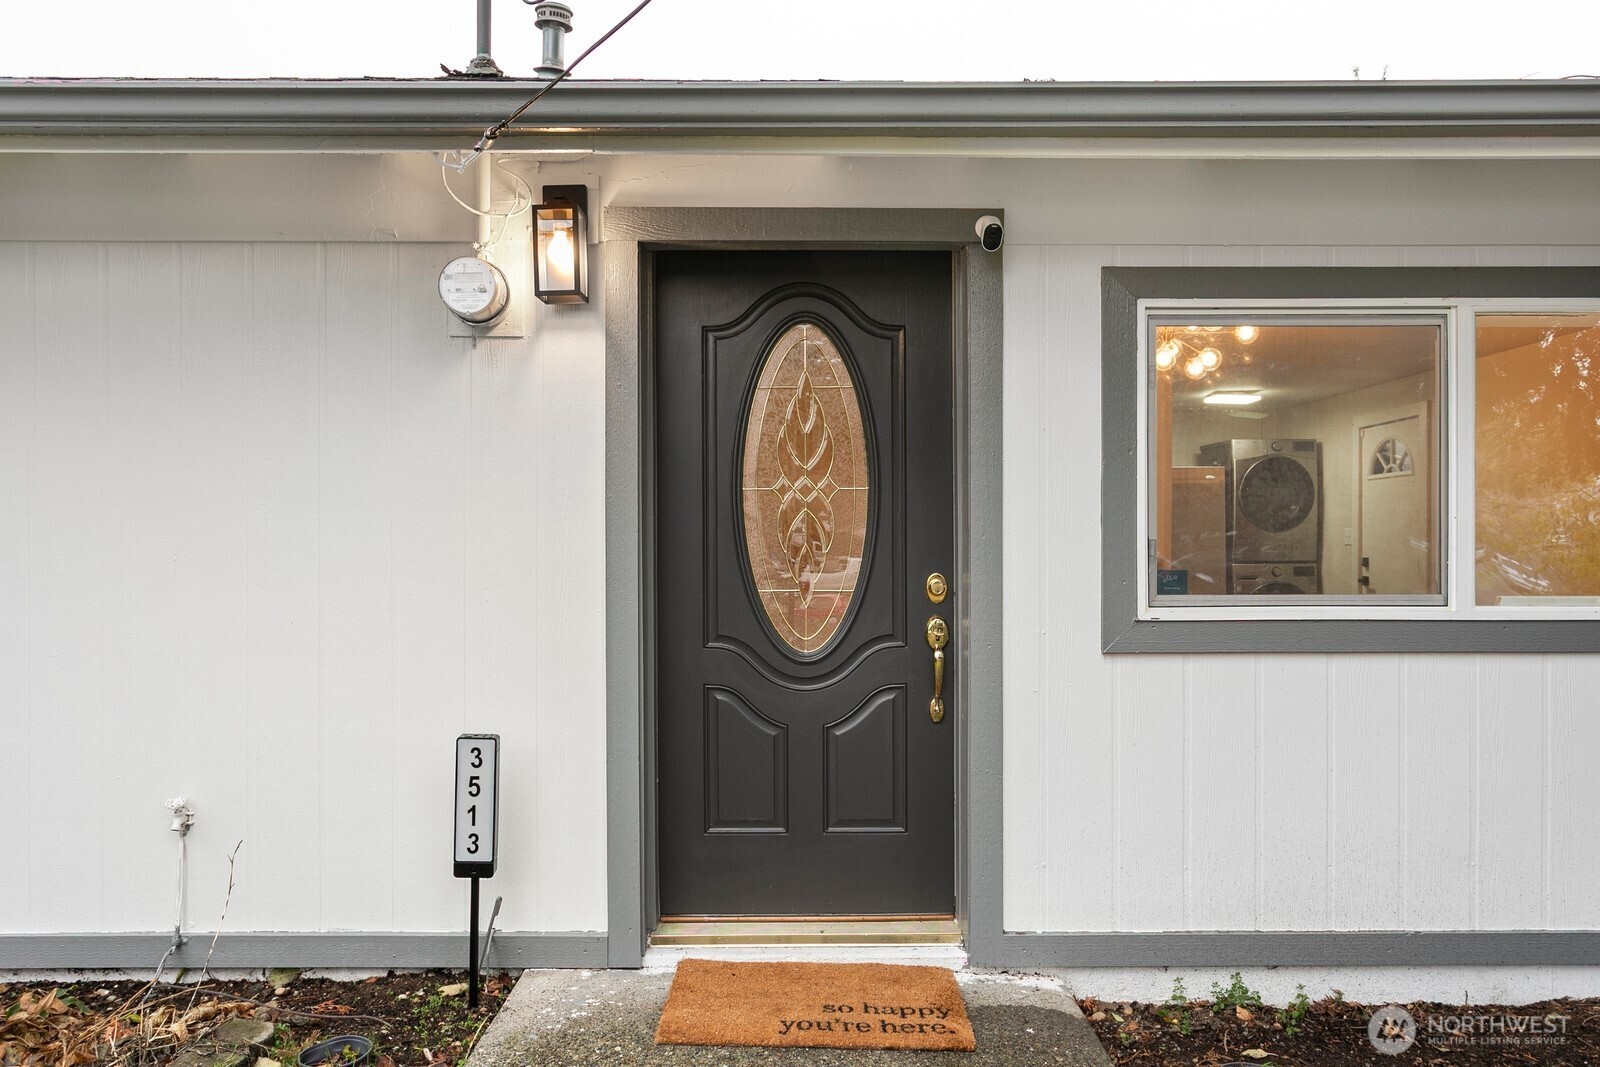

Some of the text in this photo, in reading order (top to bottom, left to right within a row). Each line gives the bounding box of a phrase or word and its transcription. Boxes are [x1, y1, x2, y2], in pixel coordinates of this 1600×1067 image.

[821, 1002, 951, 1019] so happy
[779, 1018, 956, 1035] you're here.
